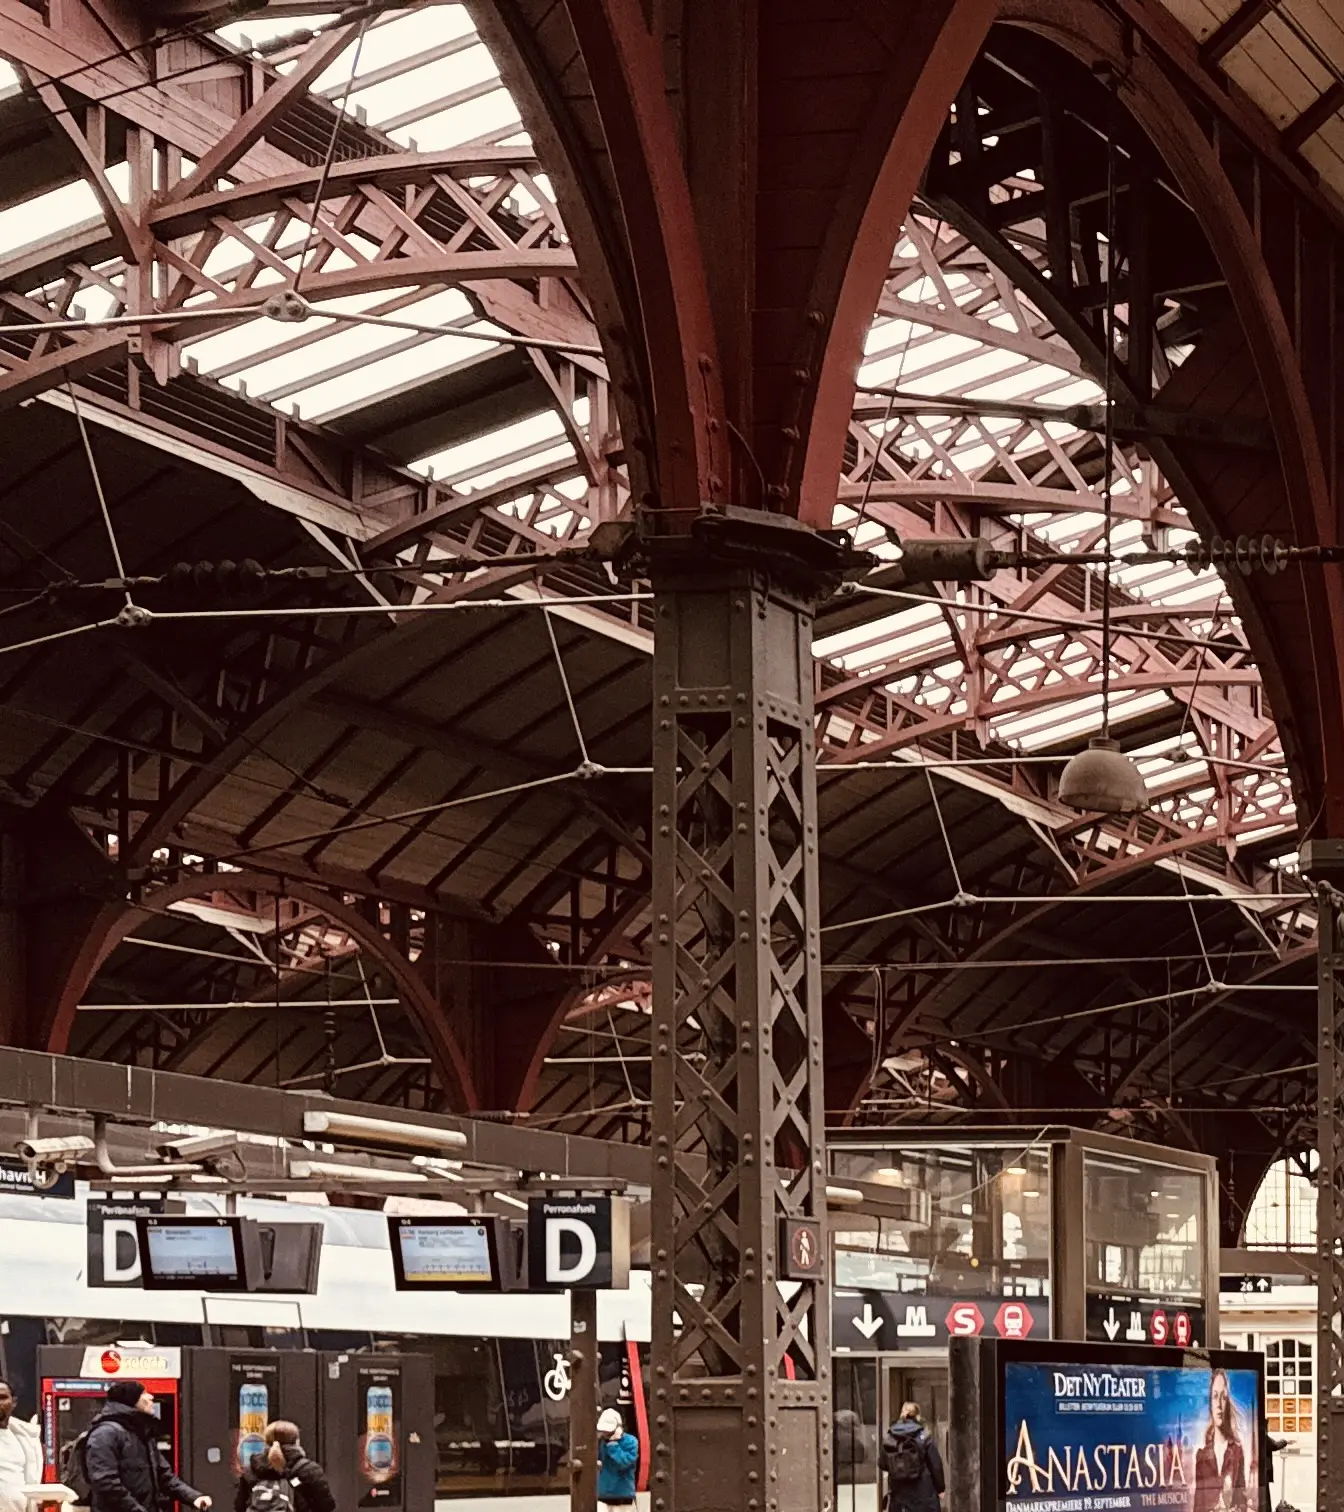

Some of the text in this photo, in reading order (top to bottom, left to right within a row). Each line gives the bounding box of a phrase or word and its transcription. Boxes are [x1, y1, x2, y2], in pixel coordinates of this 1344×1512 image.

[543, 1203, 596, 1215] Perronafsnit
[103, 1219, 142, 1282] D
[545, 1218, 597, 1282] D
[1240, 1281, 1254, 1292] 26
[953, 1308, 976, 1335] S
[1006, 1419, 1187, 1495] ANASTASIA
[1094, 1495, 1131, 1510] SEPTEMBER
[1140, 1491, 1188, 1506] THE MUSICAL
